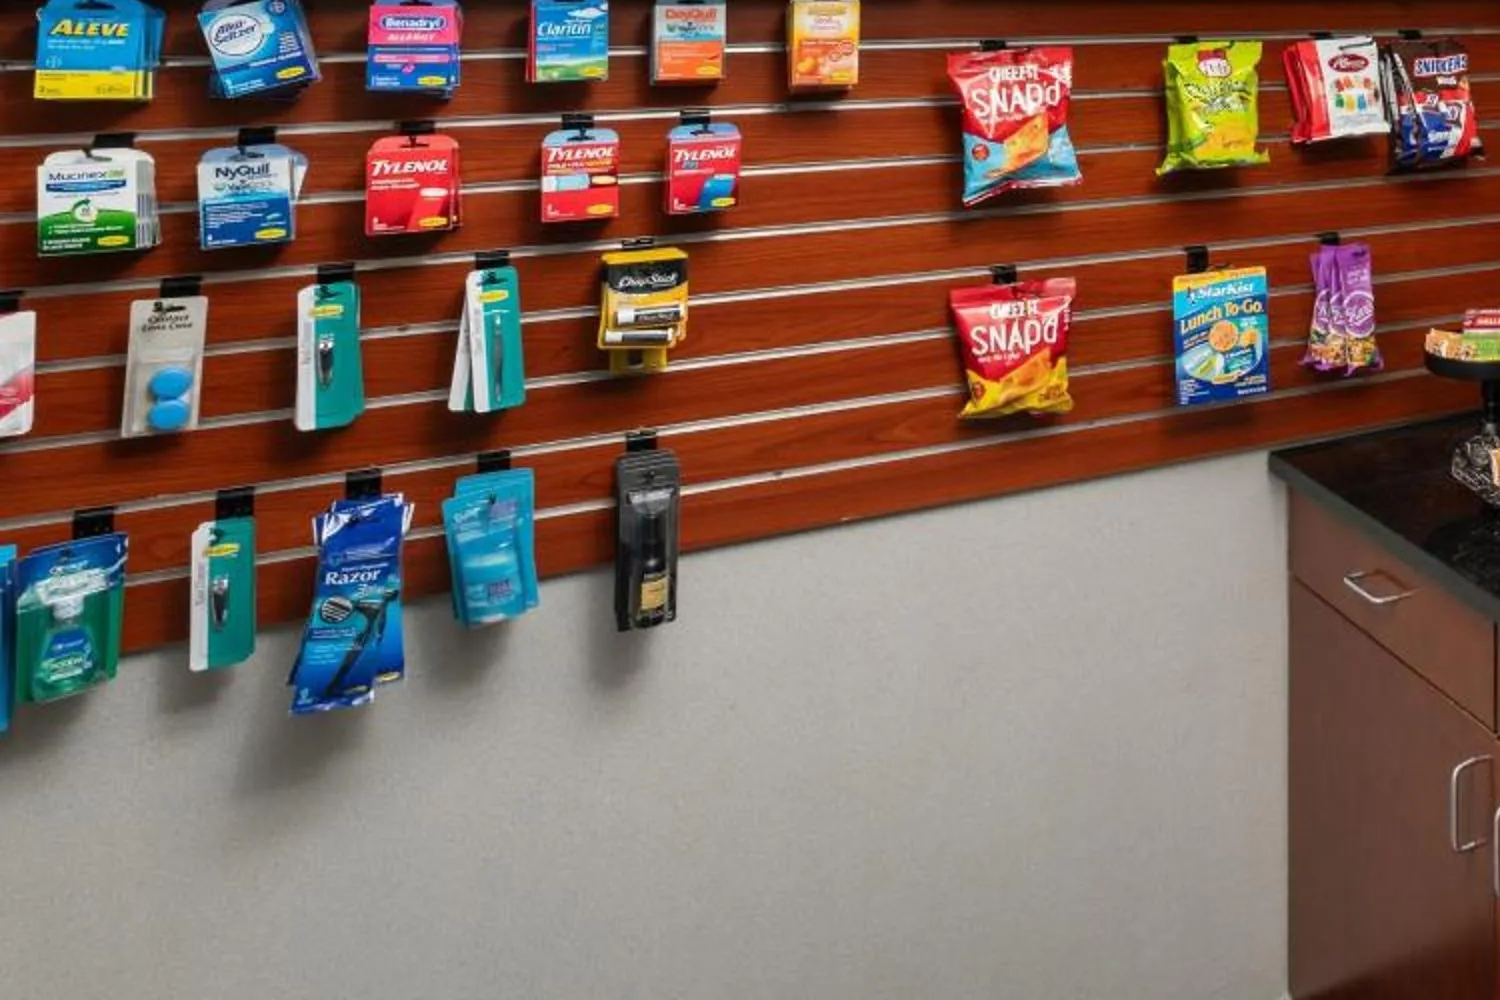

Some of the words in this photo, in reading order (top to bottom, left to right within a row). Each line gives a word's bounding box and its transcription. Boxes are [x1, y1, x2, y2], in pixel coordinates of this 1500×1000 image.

[537, 21, 592, 37] Claritin
[1415, 53, 1468, 76] SNICKERS
[547, 146, 615, 163] TYLENOL
[673, 148, 737, 163] TYLENOL
[48, 169, 107, 181] Mucinex
[215, 162, 271, 180] NyQuil
[370, 159, 449, 177] TYLENOL
[1196, 280, 1254, 299] StarKist
[1180, 305, 1222, 334] Lunch
[324, 567, 382, 585] Razor
